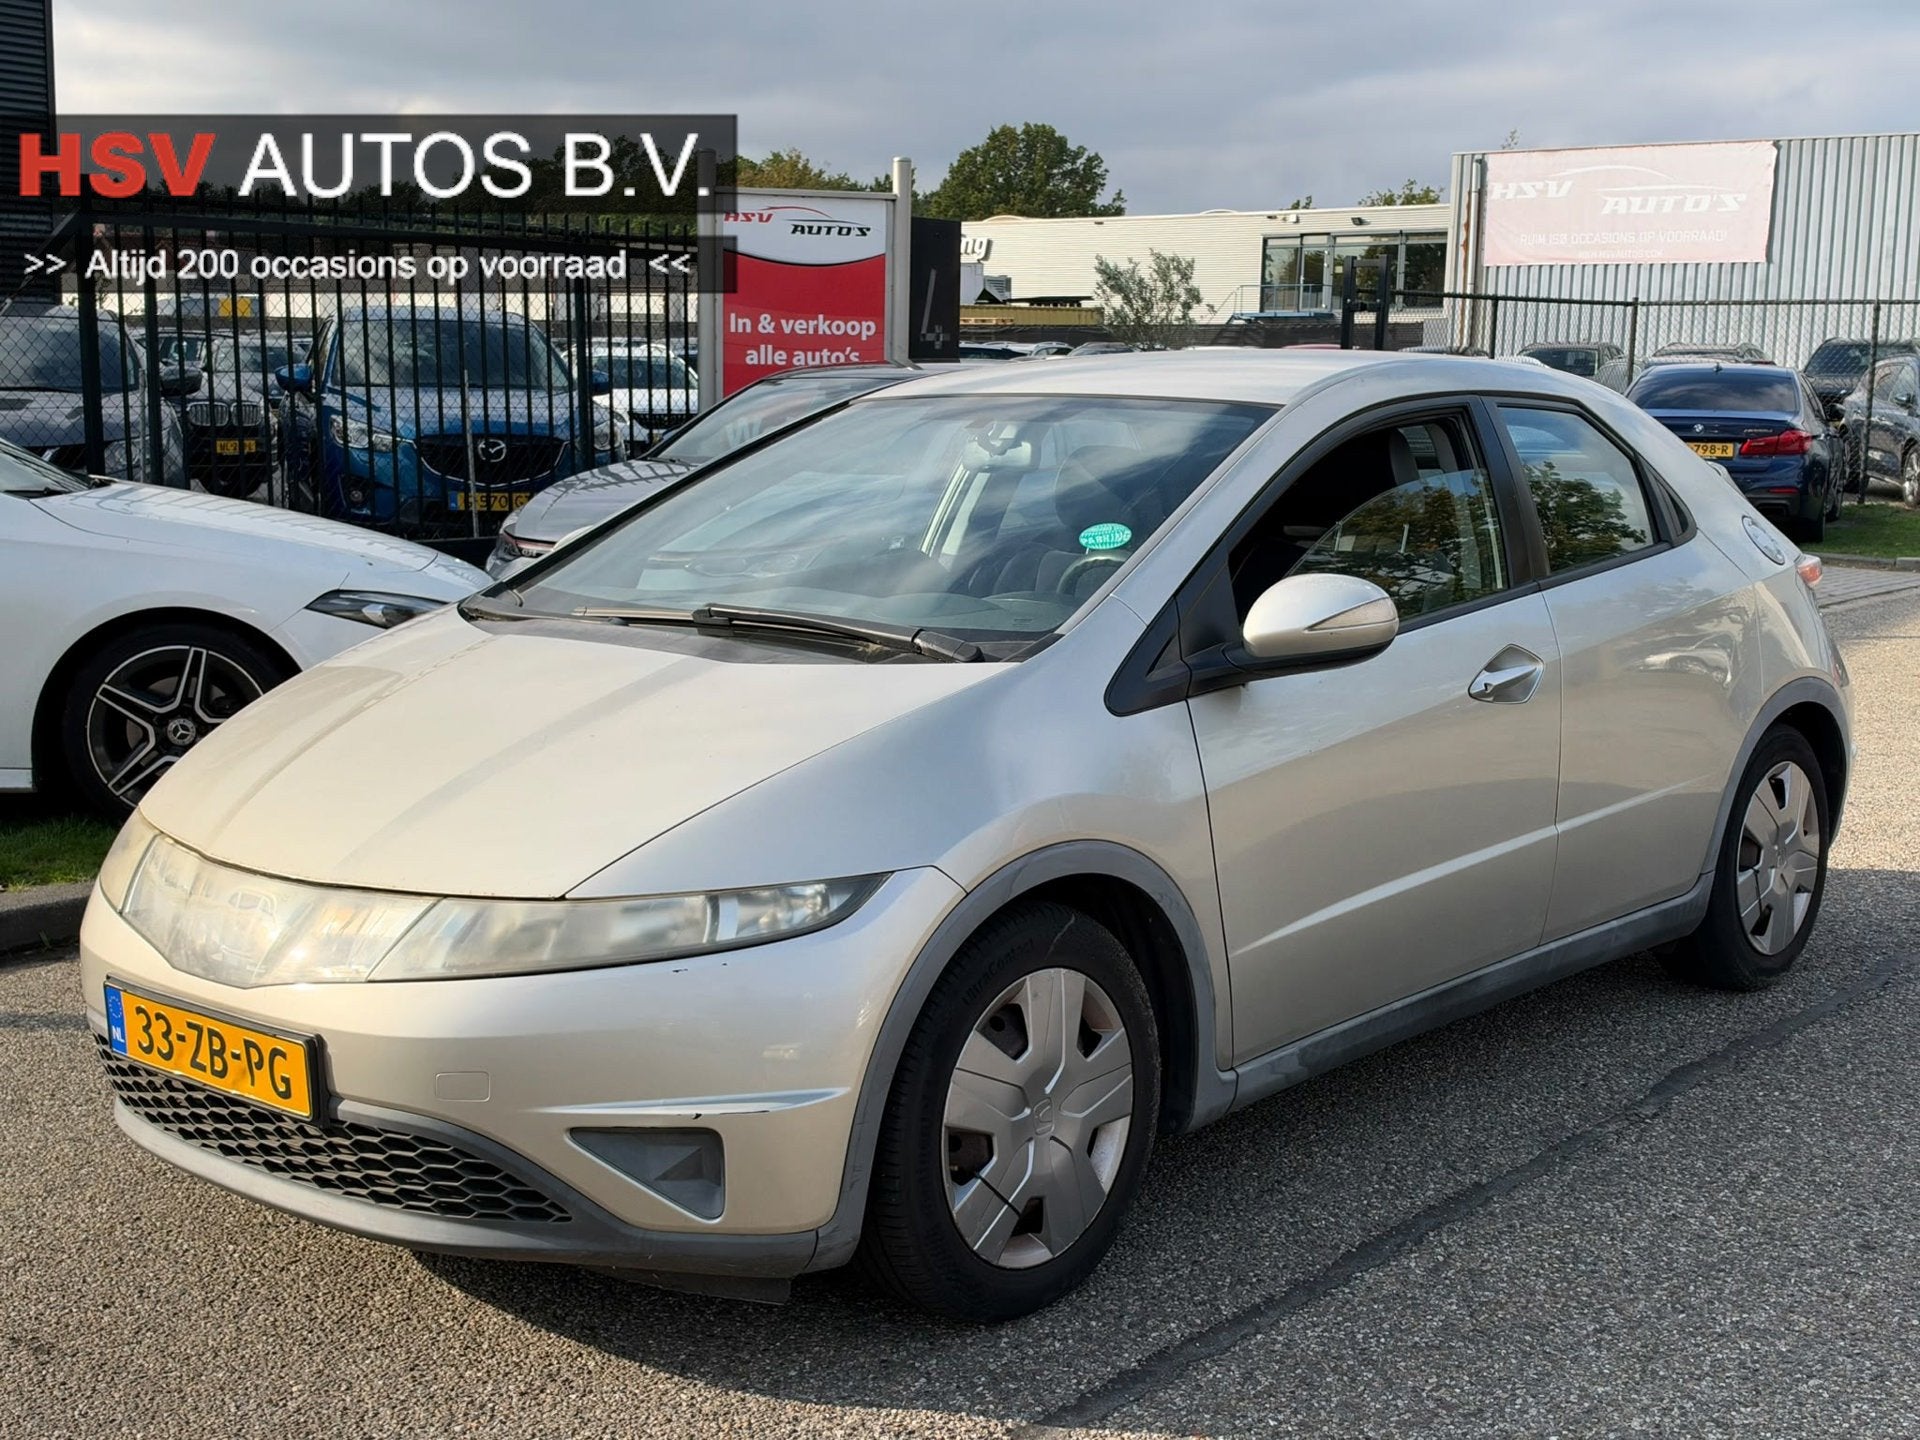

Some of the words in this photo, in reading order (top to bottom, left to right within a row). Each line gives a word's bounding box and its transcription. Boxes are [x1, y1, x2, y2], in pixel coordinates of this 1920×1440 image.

[1490, 180, 1574, 200] HSV
[1601, 193, 1748, 215] AUTO'S
[724, 212, 773, 223] HSV
[790, 224, 871, 237] AUTO'S
[960, 237, 990, 260] ng
[1519, 233, 1546, 247] RUIM
[1570, 231, 1635, 245] OCCASIONS
[1638, 231, 1656, 243] OP
[729, 312, 752, 333] In
[757, 313, 775, 334] &
[780, 313, 876, 341] verkoop
[745, 344, 788, 366] alle
[792, 346, 860, 367] auto's
[111, 1025, 125, 1043] NL
[134, 1004, 293, 1101] 33-ZB-PG
